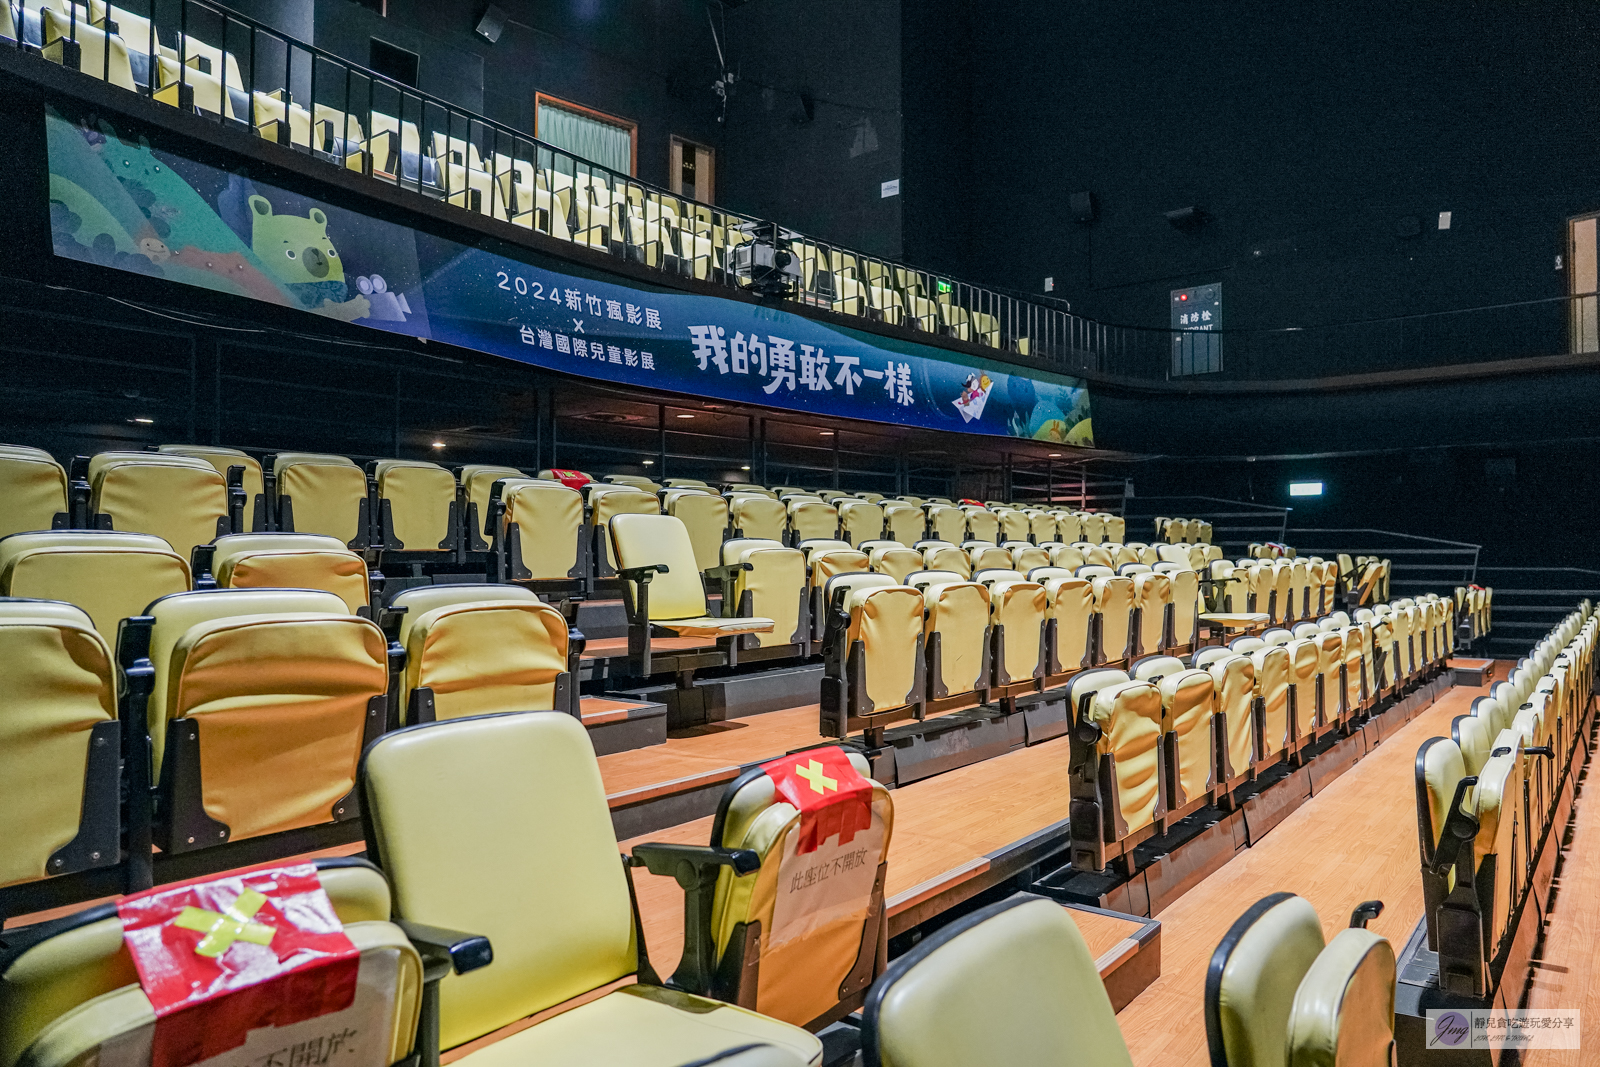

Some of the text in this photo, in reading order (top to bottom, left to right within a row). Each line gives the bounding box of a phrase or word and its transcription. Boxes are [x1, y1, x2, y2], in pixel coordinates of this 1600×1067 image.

[496, 271, 663, 330] 2024新竹瘋影展
[1180, 310, 1212, 325] 消防栓
[519, 324, 656, 371] 台灣國際兒童影展
[687, 324, 915, 407] 我的勇敢不一樣
[789, 847, 868, 894] 此座位不開放
[245, 1027, 358, 1067] 不開放
